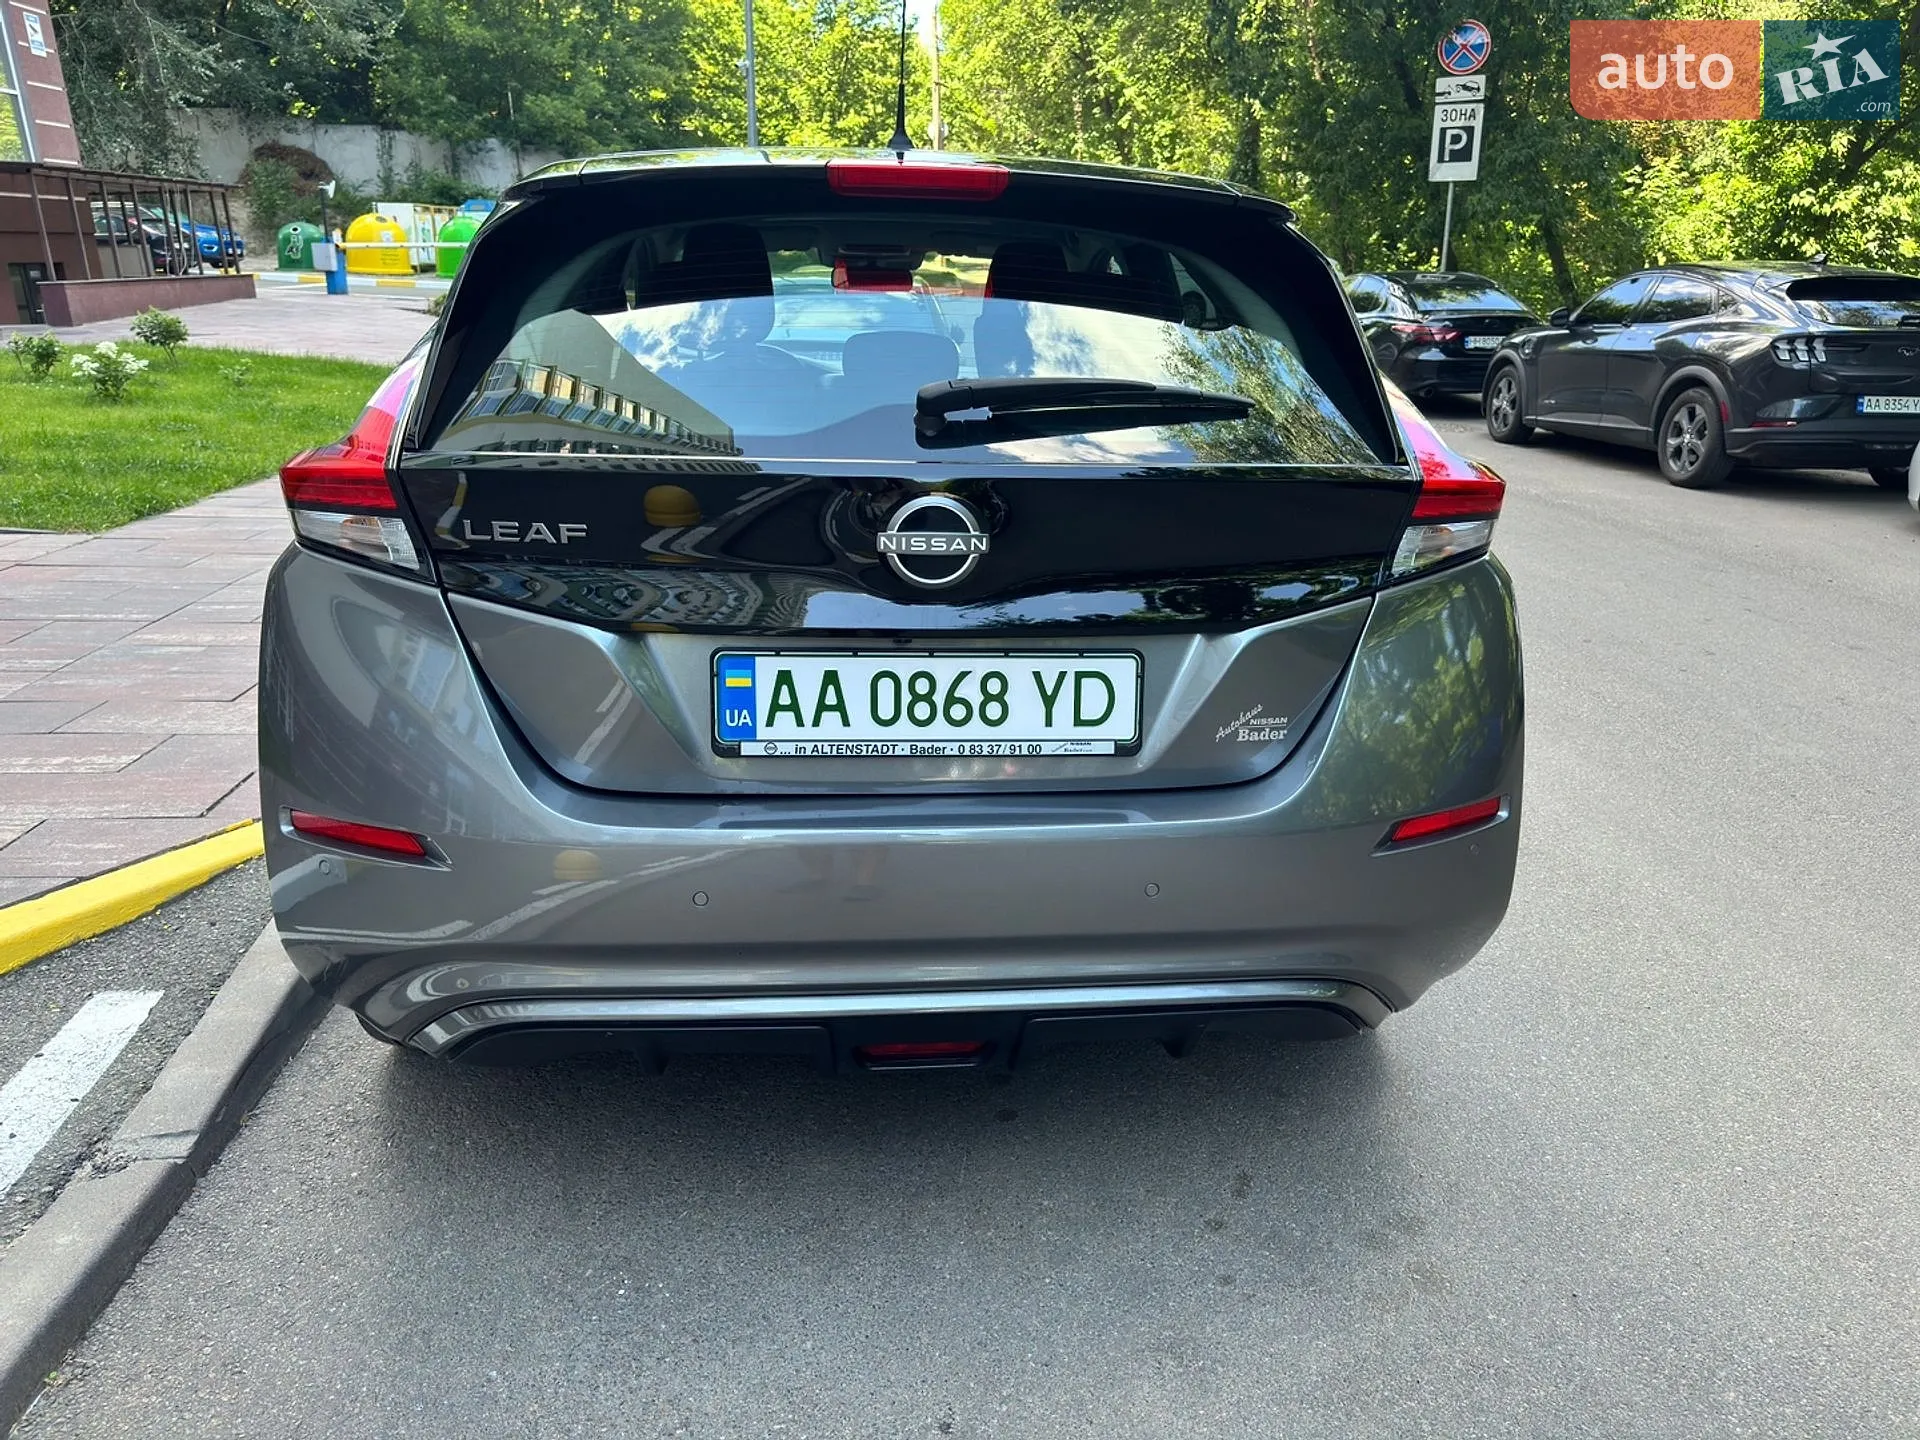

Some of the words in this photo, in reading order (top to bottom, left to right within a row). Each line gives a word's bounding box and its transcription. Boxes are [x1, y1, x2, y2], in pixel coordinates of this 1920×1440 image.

[1441, 108, 1476, 123] ЗОНА
[1443, 128, 1468, 162] P
[1865, 398, 1881, 411] AA
[1884, 398, 1910, 411] 8354
[463, 519, 588, 544] LEAF
[880, 536, 987, 552] NISSAN
[765, 669, 851, 728] AA
[869, 669, 1010, 728] 0868
[1032, 670, 1116, 728] YD
[725, 708, 753, 727] UA
[1237, 728, 1288, 742] Bader
[794, 743, 807, 755] in
[810, 743, 898, 755] ALTENSTADT
[909, 743, 947, 755] Bader
[968, 743, 984, 755] 83
